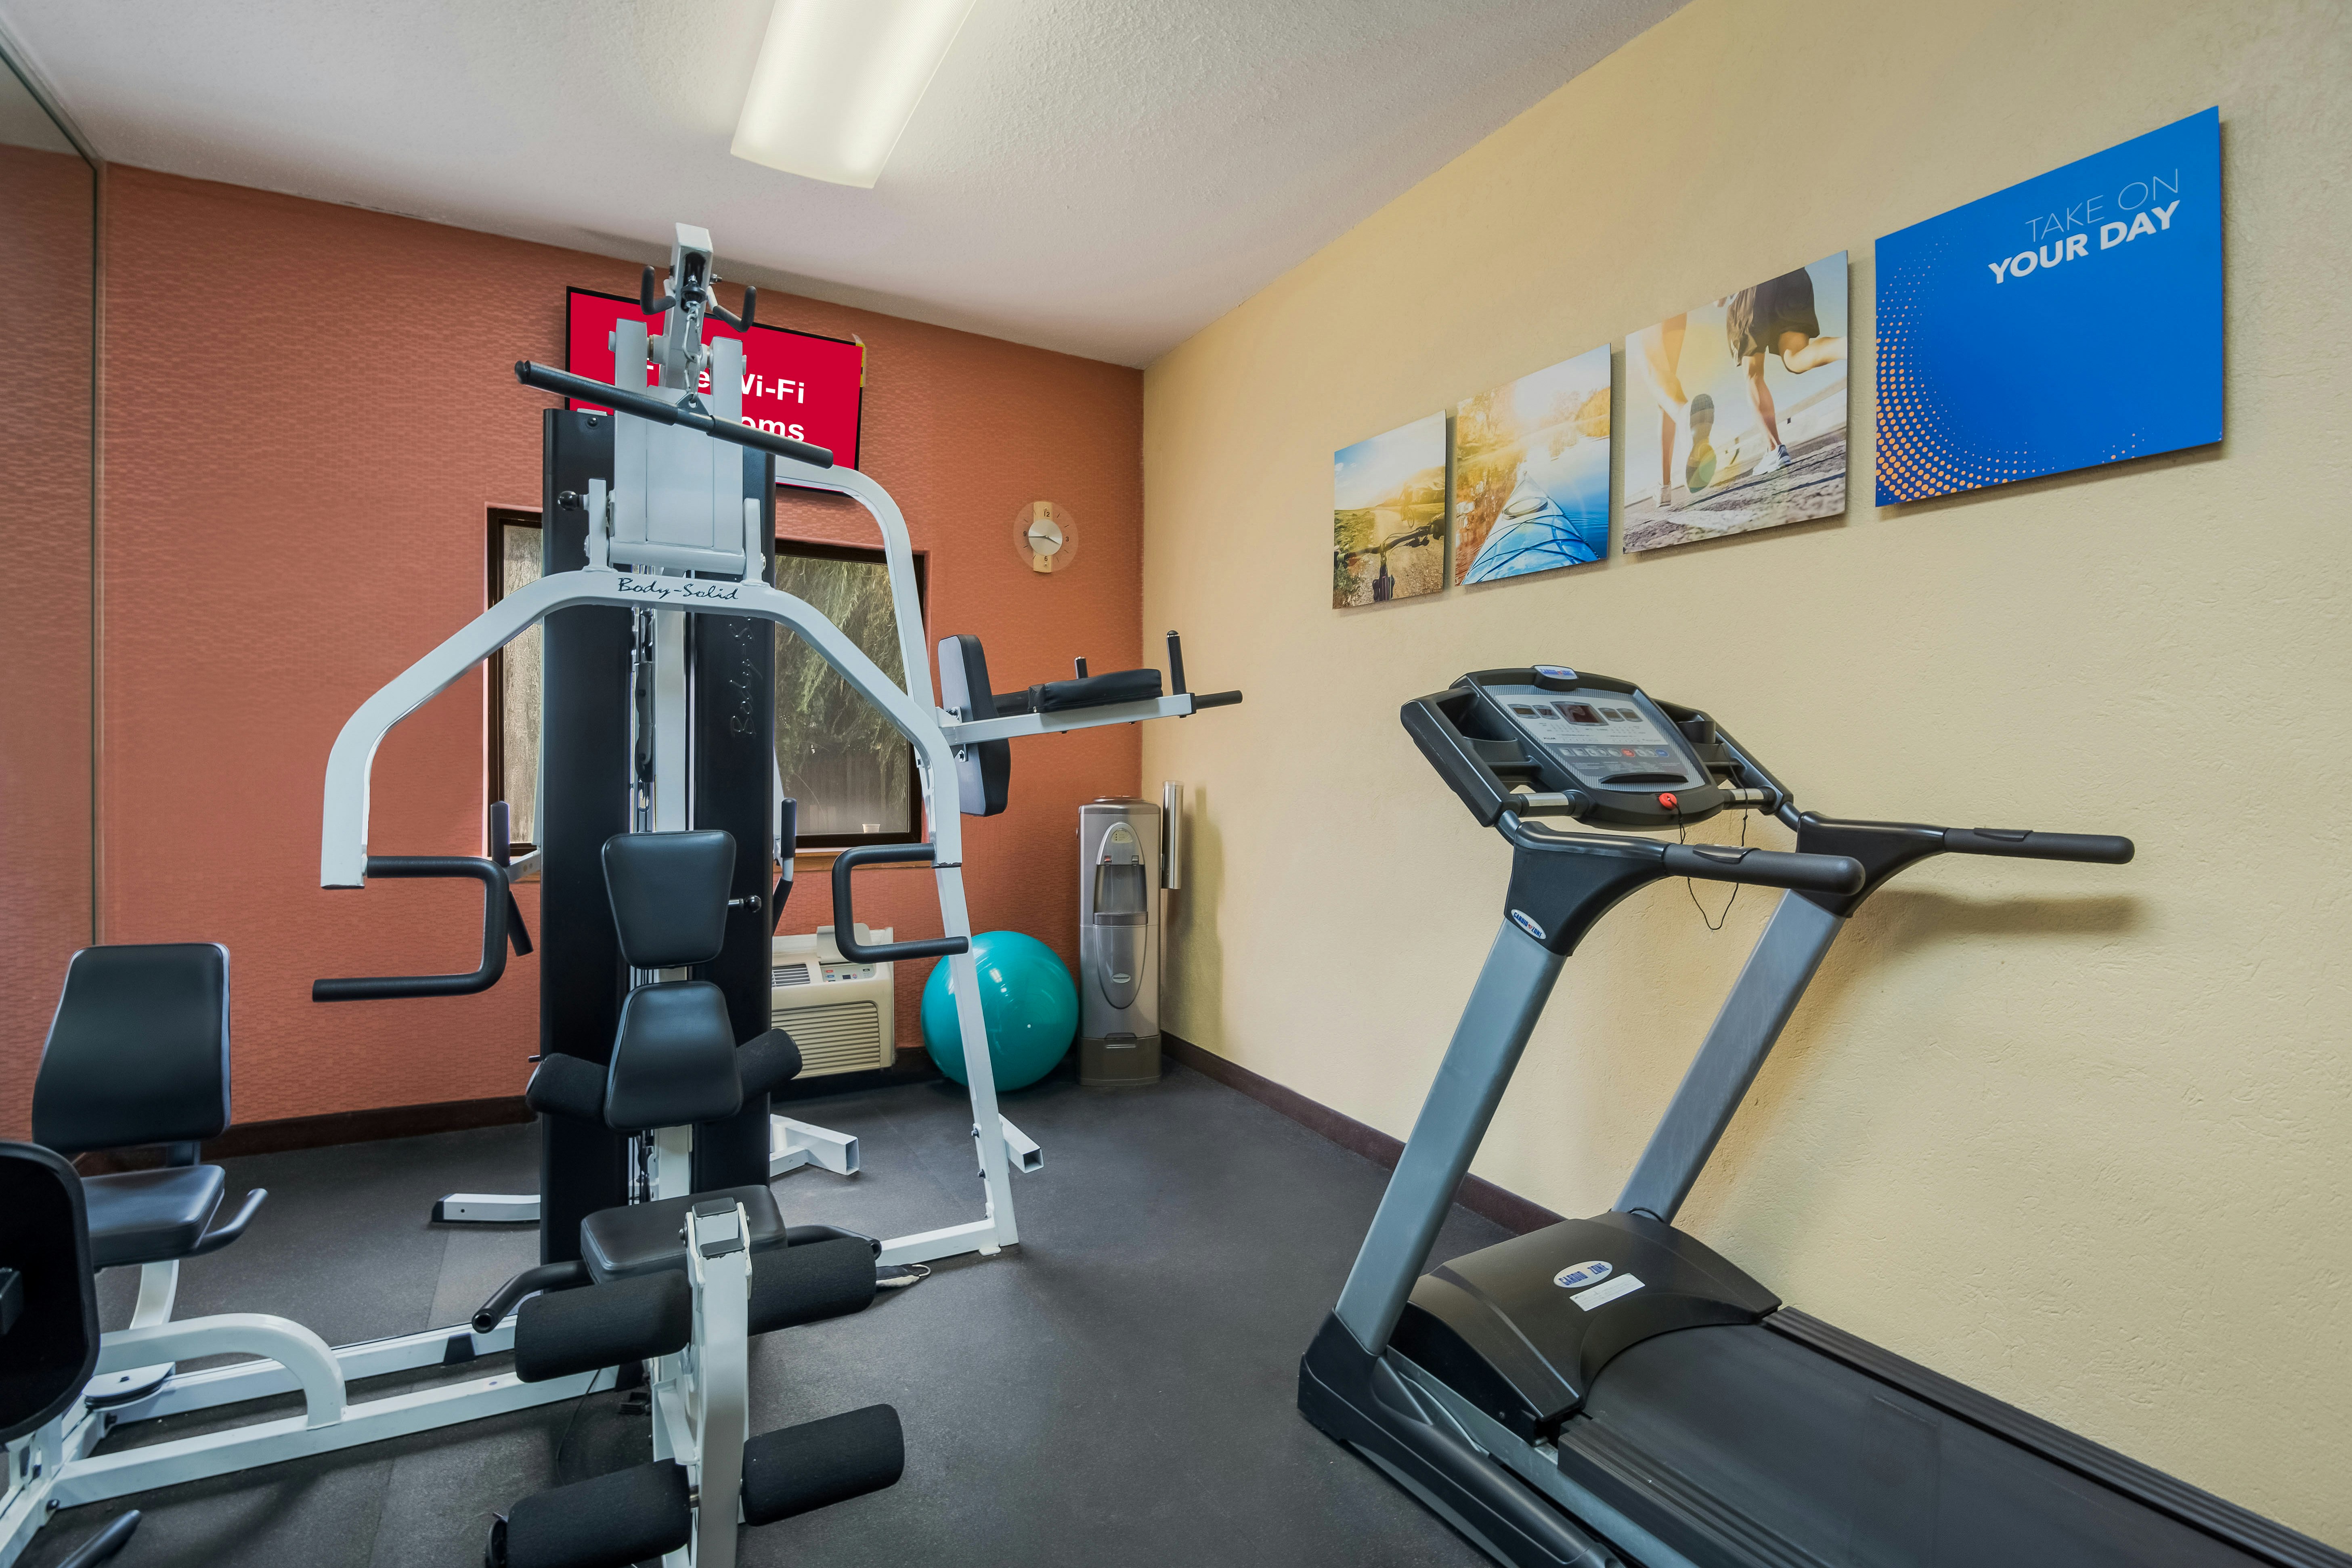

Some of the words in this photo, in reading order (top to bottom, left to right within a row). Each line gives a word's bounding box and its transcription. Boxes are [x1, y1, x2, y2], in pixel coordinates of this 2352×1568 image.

[1988, 233, 2089, 284] YOUR
[2100, 199, 2180, 250] DAY
[2025, 195, 2105, 242] TAKE
[2118, 168, 2178, 210] ON
[618, 577, 739, 600] Body-Solid
[729, 616, 763, 740] Body-S
